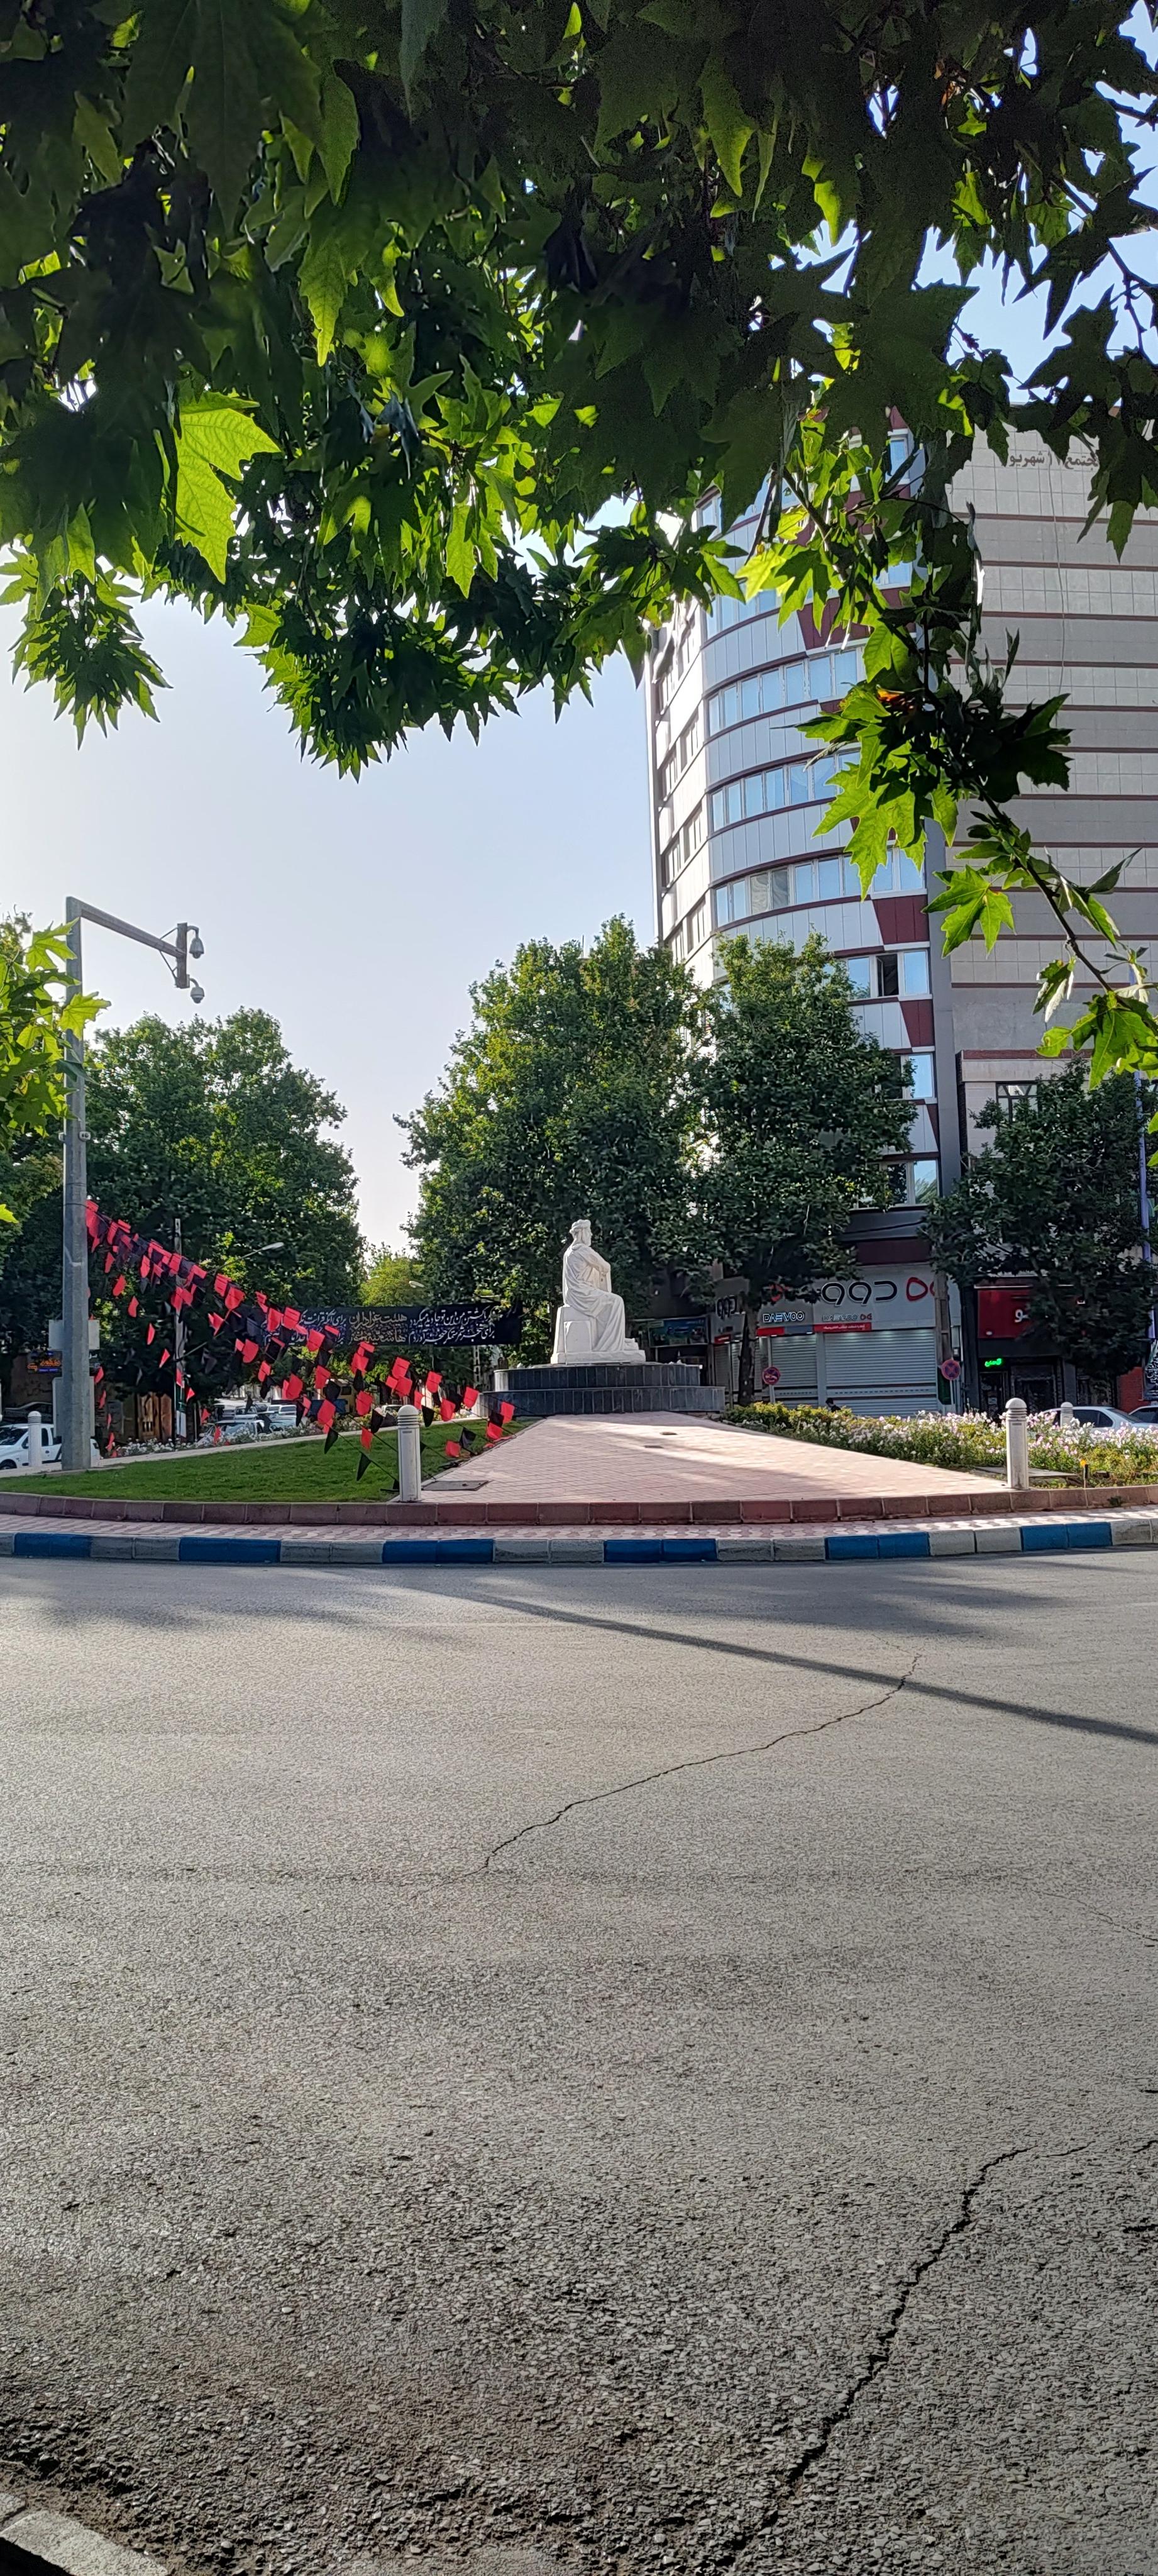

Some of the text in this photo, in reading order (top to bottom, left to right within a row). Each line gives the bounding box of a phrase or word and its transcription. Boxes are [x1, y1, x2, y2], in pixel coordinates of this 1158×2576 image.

[1009, 450, 1045, 467] شهریو
[821, 1280, 898, 1307] دوو
[763, 1311, 805, 1323] DAEWOO
[822, 1313, 859, 1323] DAEWOO
